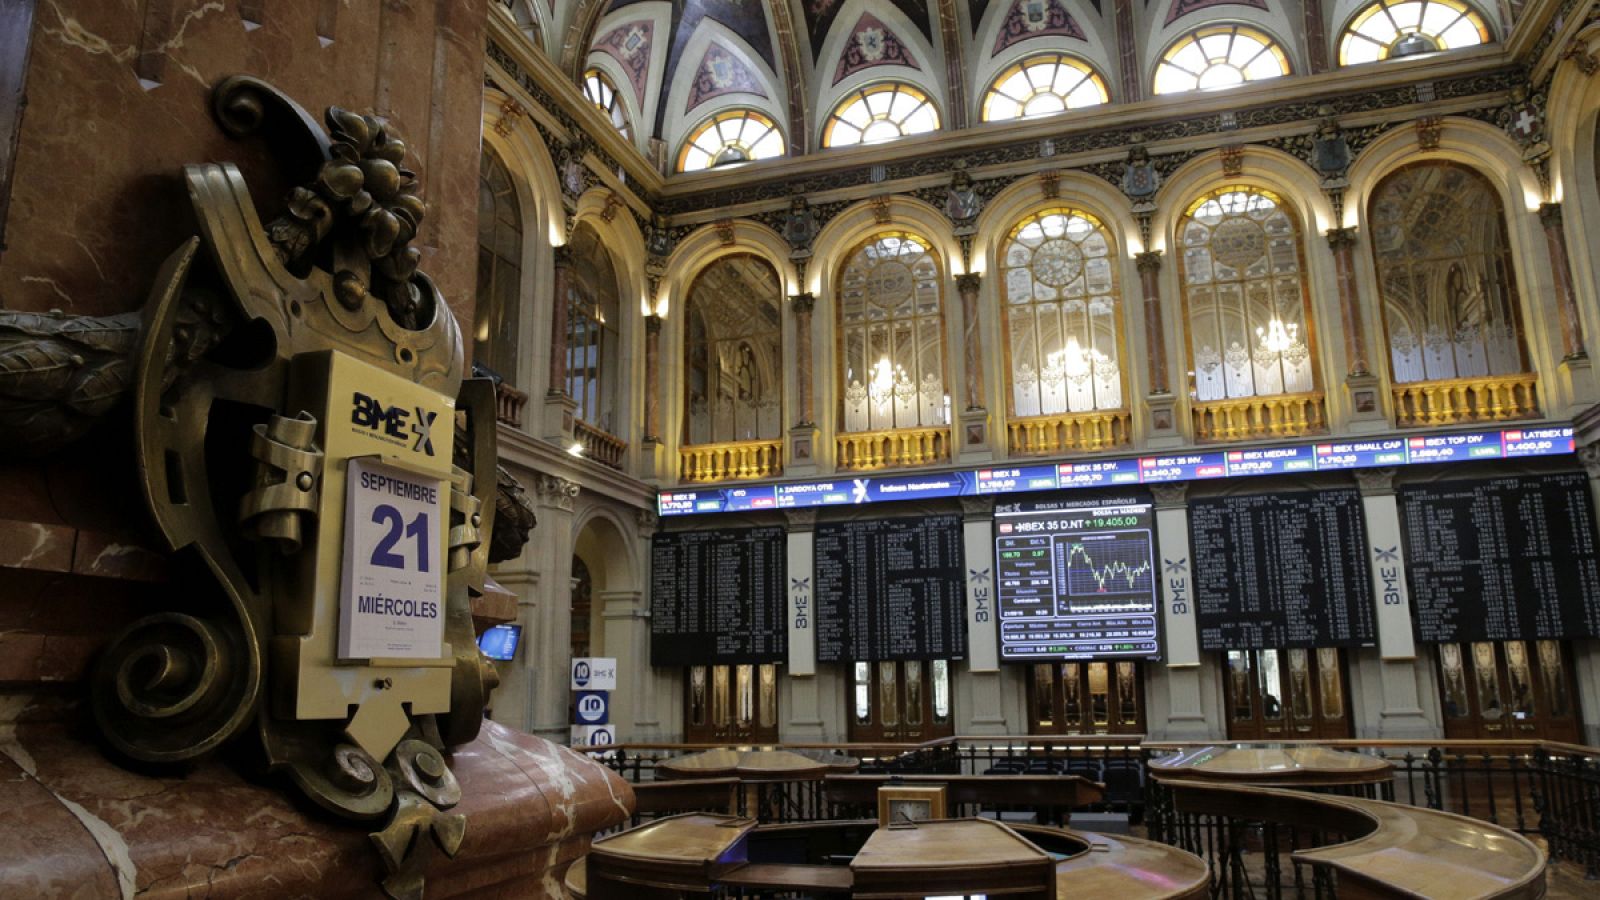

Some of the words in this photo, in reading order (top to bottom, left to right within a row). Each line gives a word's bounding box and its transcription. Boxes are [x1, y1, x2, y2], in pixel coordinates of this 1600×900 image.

[1426, 438, 1446, 446] IBEX
[1447, 436, 1466, 444] TOP
[1467, 435, 1483, 443] DIV
[1523, 430, 1561, 439] LATIBEX
[1333, 445, 1353, 453] IBEX
[1354, 443, 1382, 451] SMALL
[1383, 441, 1402, 449] CAP
[1243, 451, 1264, 459] IBEX
[1264, 449, 1297, 458] MEDIUM
[1074, 464, 1092, 472] IBEX
[1103, 462, 1119, 471] DIV.
[361, 471, 437, 505] SEPTIEMBRE
[784, 485, 817, 493] ZARDOYA
[907, 481, 950, 491] Nacionales
[1101, 497, 1137, 505] ESPAÑOLES
[1047, 520, 1059, 530] 35
[1060, 519, 1084, 529] D.NT
[370, 504, 429, 572] 21
[1380, 567, 1400, 605] BME
[1170, 578, 1187, 614] BME
[358, 593, 437, 619] MIÉRCOLES
[974, 588, 989, 622] BME
[794, 596, 807, 628] BME
[576, 665, 589, 678] 10
[584, 698, 601, 712] 10
[594, 731, 610, 745] 10
